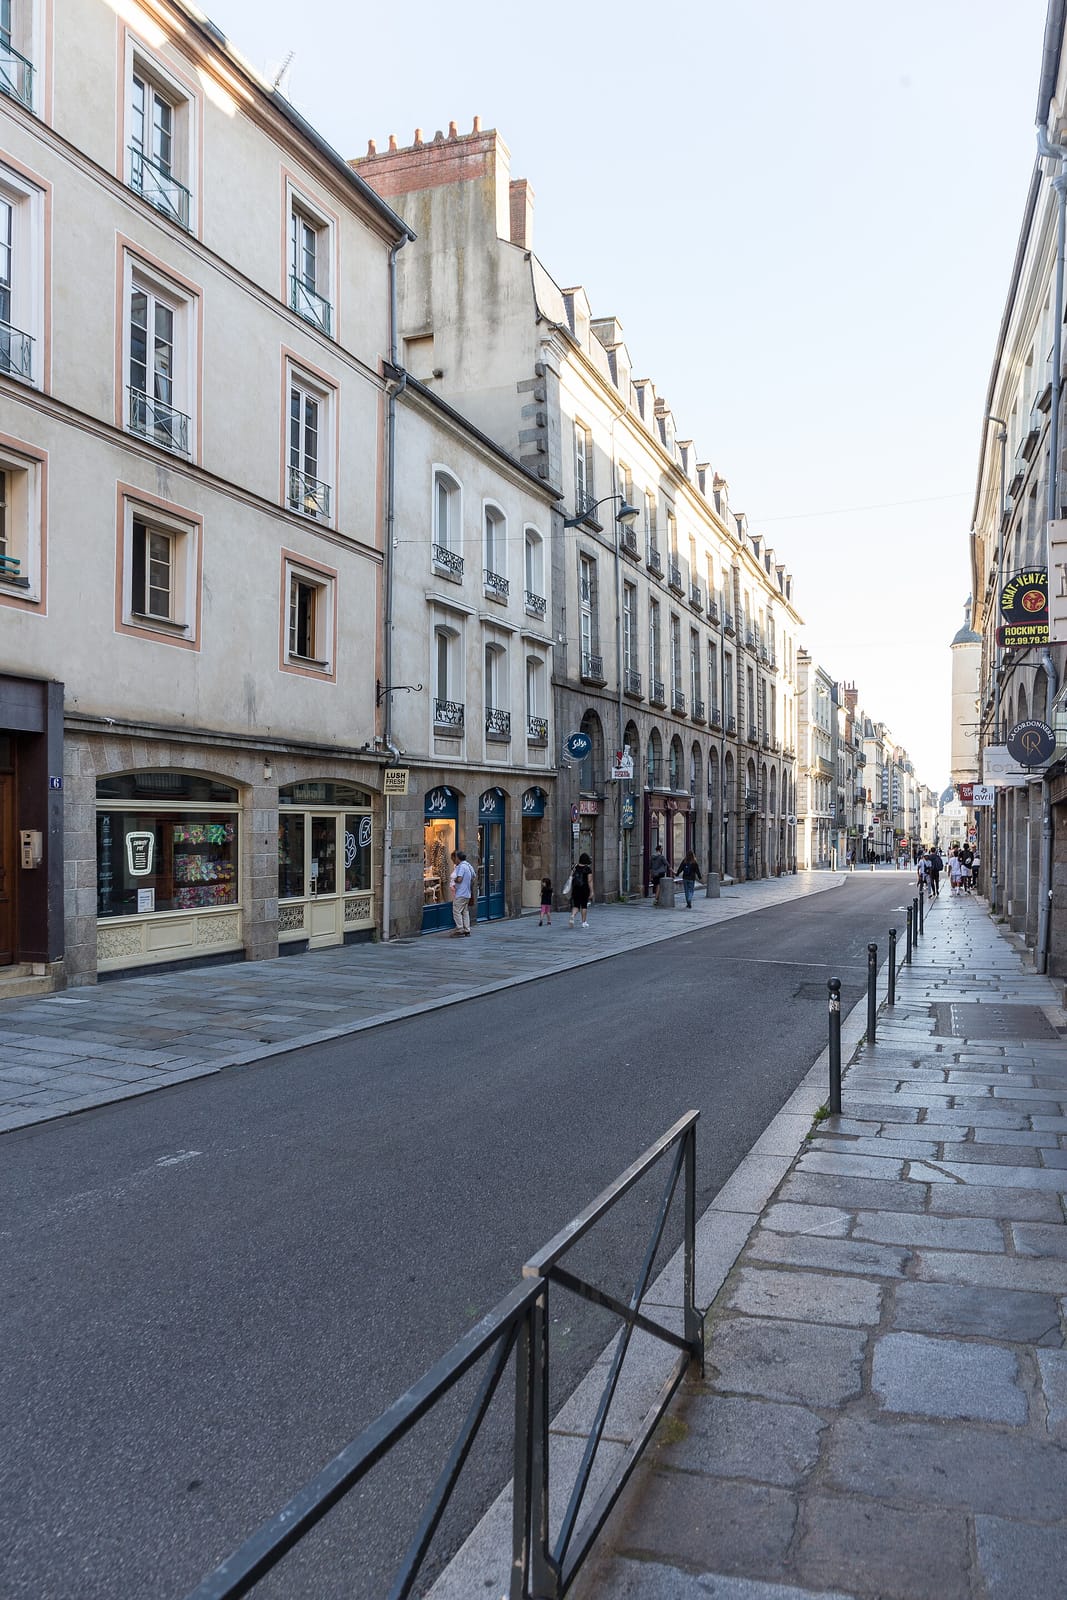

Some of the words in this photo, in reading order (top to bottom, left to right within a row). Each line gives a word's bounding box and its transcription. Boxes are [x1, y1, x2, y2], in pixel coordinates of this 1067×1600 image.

[1009, 733, 1016, 742] LA
[1014, 721, 1055, 741] CORDONNERIE
[572, 738, 587, 750] Salsa
[53, 777, 60, 788] 6
[428, 791, 447, 811] Salsa
[481, 793, 496, 812] Salsa
[523, 793, 535, 810] Salsa
[974, 793, 994, 801] avril
